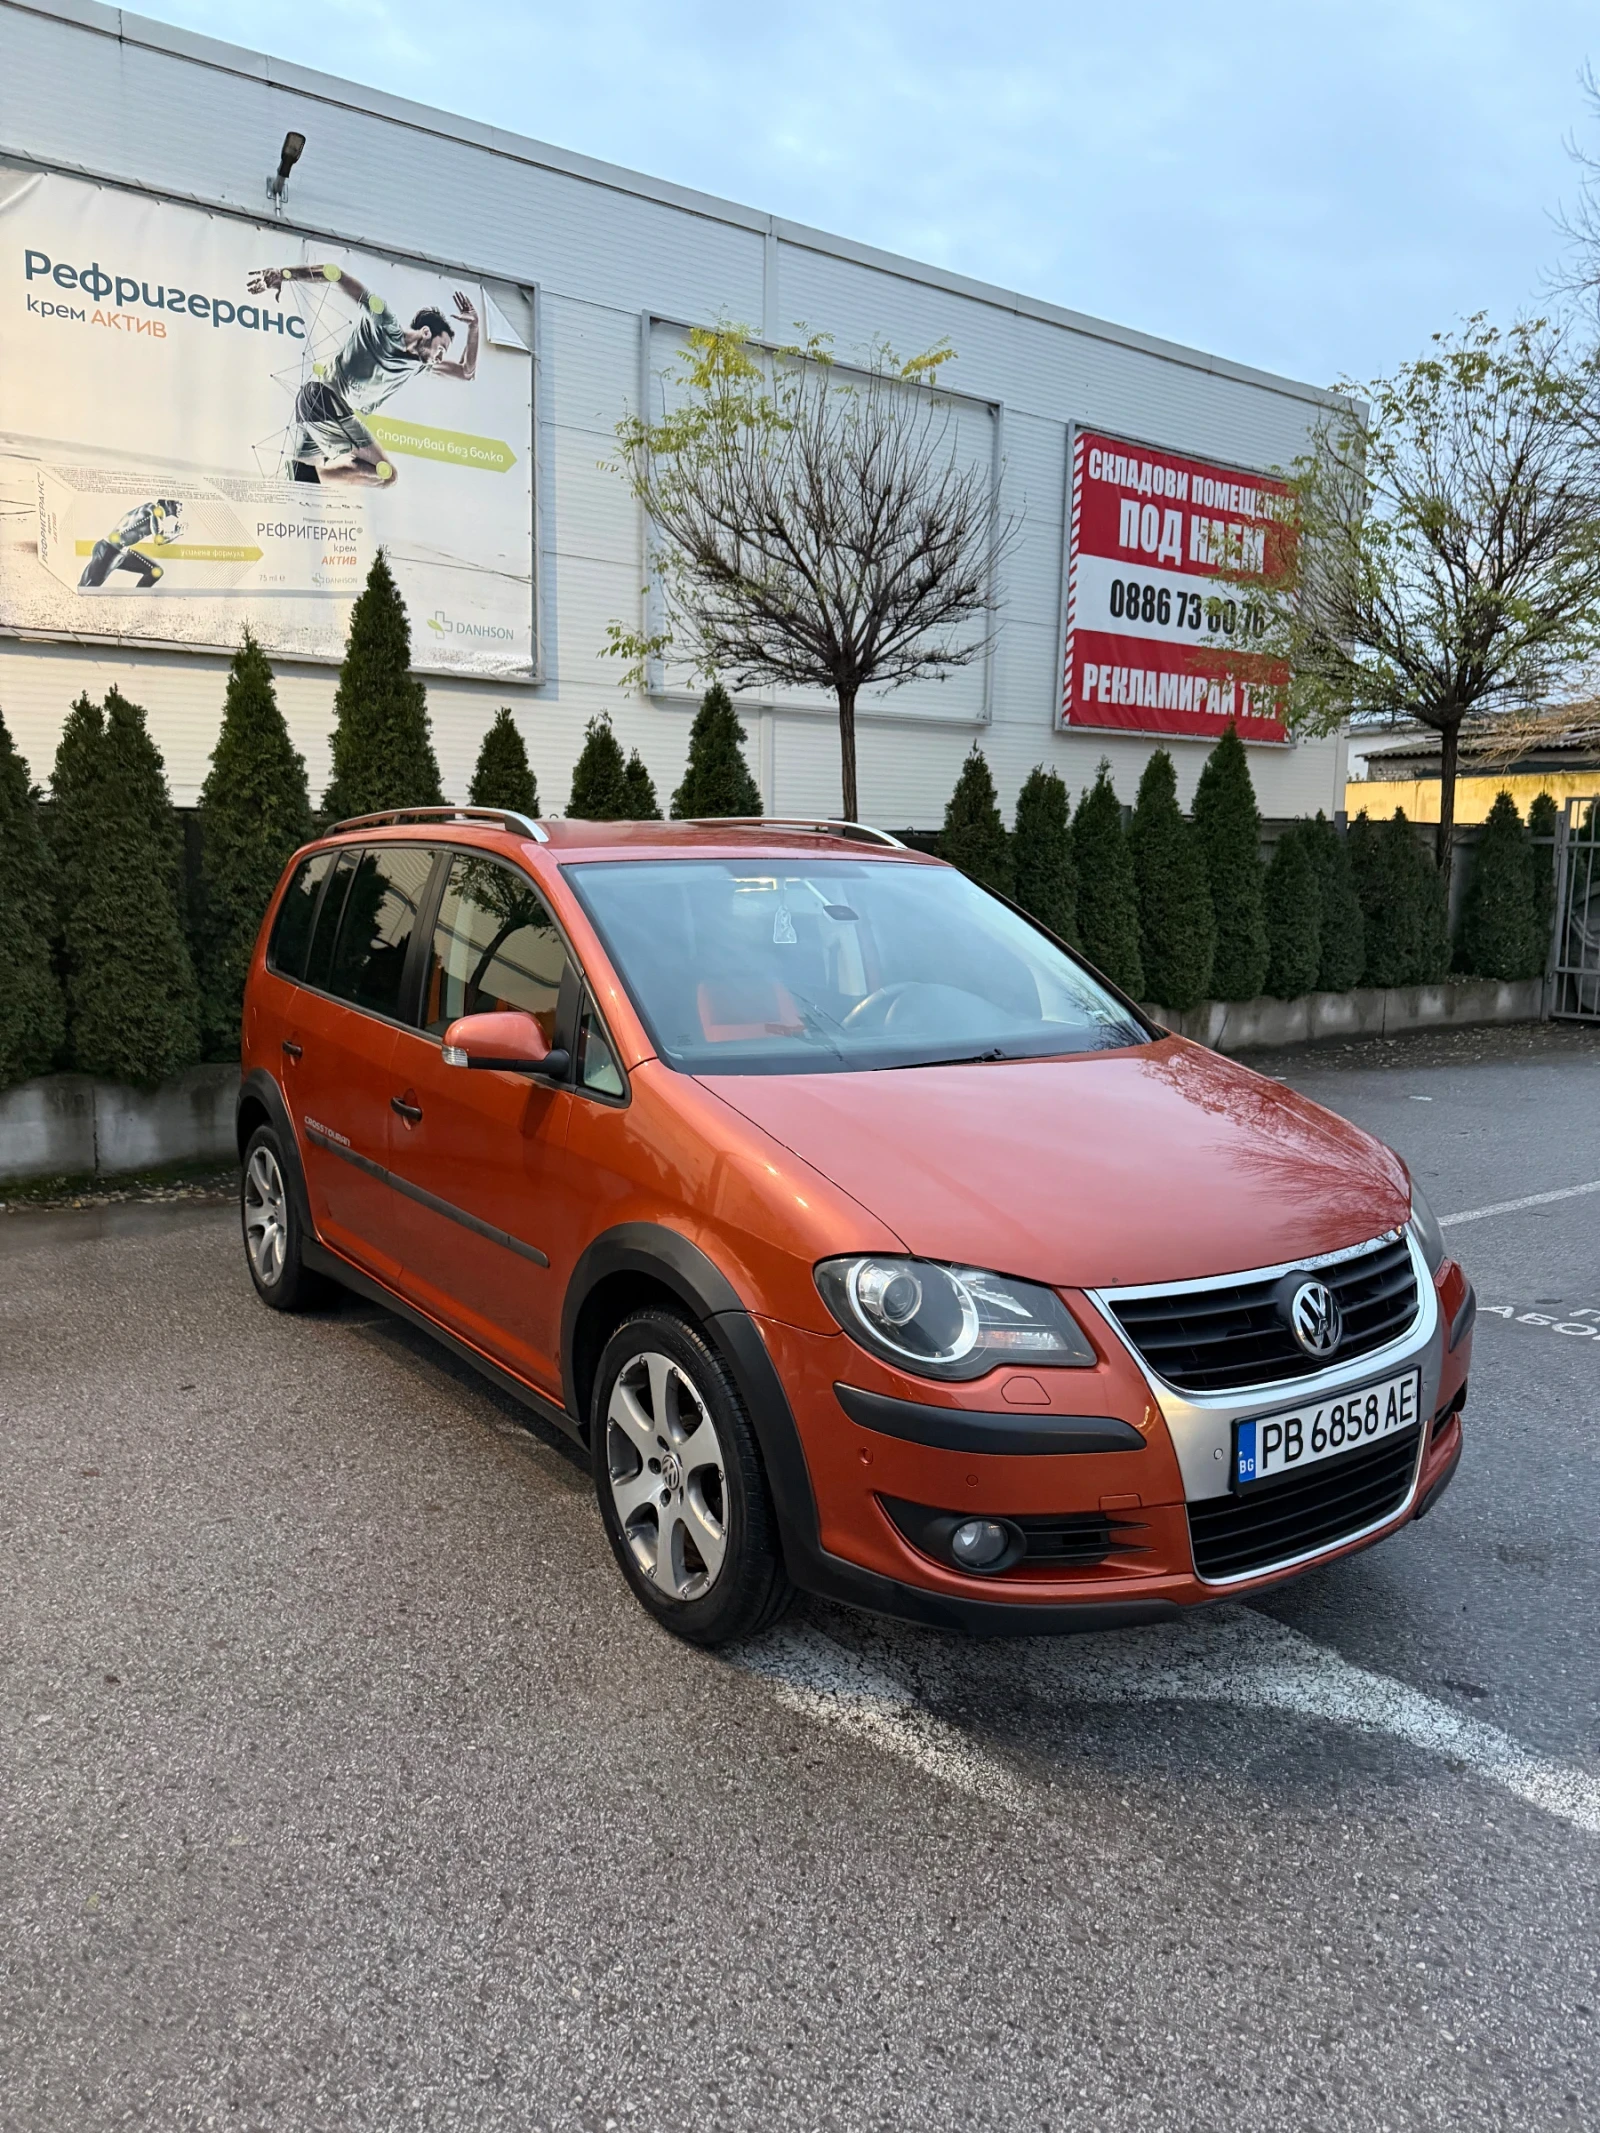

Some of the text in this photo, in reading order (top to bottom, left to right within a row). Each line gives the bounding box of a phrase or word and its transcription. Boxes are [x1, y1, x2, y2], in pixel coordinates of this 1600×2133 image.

[24, 249, 306, 340] Рефригеранс
[26, 293, 168, 339] крем АКТИВ
[376, 428, 505, 463] Спортувай без болка
[1088, 447, 1189, 502] СКЛАДОВИ
[333, 544, 357, 553] крем
[1119, 498, 1183, 567] ПОД
[321, 556, 357, 566] АКТИВ
[1110, 579, 1171, 626] 0886
[1176, 591, 1202, 630] 73
[456, 622, 514, 640] DANHSON
[1082, 662, 1236, 715] РЕКЛАМИРАЙ
[1476, 1306, 1600, 1340] АБО
[1262, 1378, 1413, 1470] PB 6858 AE
[1239, 1458, 1254, 1474] BG
